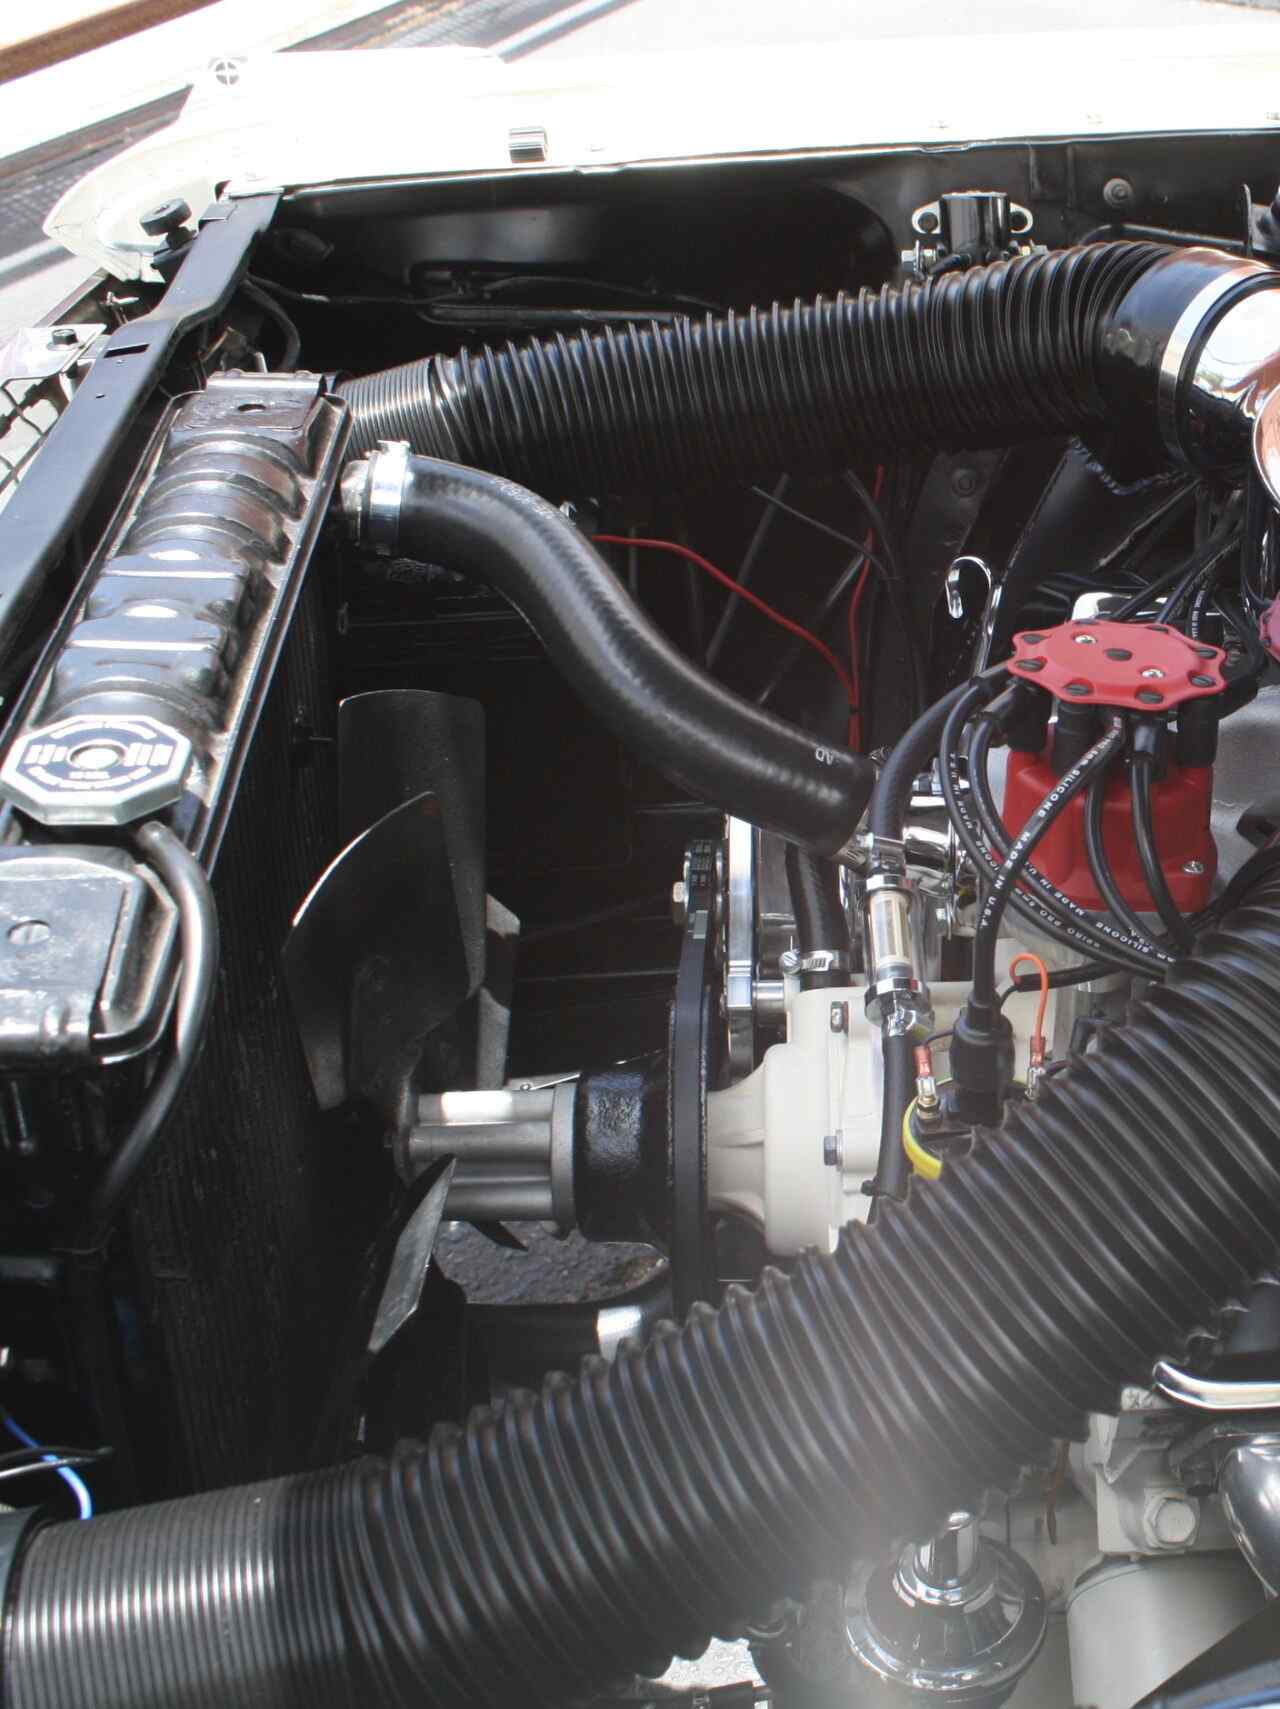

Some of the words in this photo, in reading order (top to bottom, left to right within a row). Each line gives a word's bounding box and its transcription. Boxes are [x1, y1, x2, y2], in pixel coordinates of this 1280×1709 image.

[1037, 768, 1081, 818] SILICONE
[1005, 831, 1031, 869] MADE
[995, 875, 1006, 890] IN
[1040, 878, 1053, 889] IN
[1054, 891, 1086, 917] MADE
[1039, 909, 1063, 927] PRO
[1067, 927, 1100, 948] SPIRO
[1095, 922, 1150, 953] SILICONE
